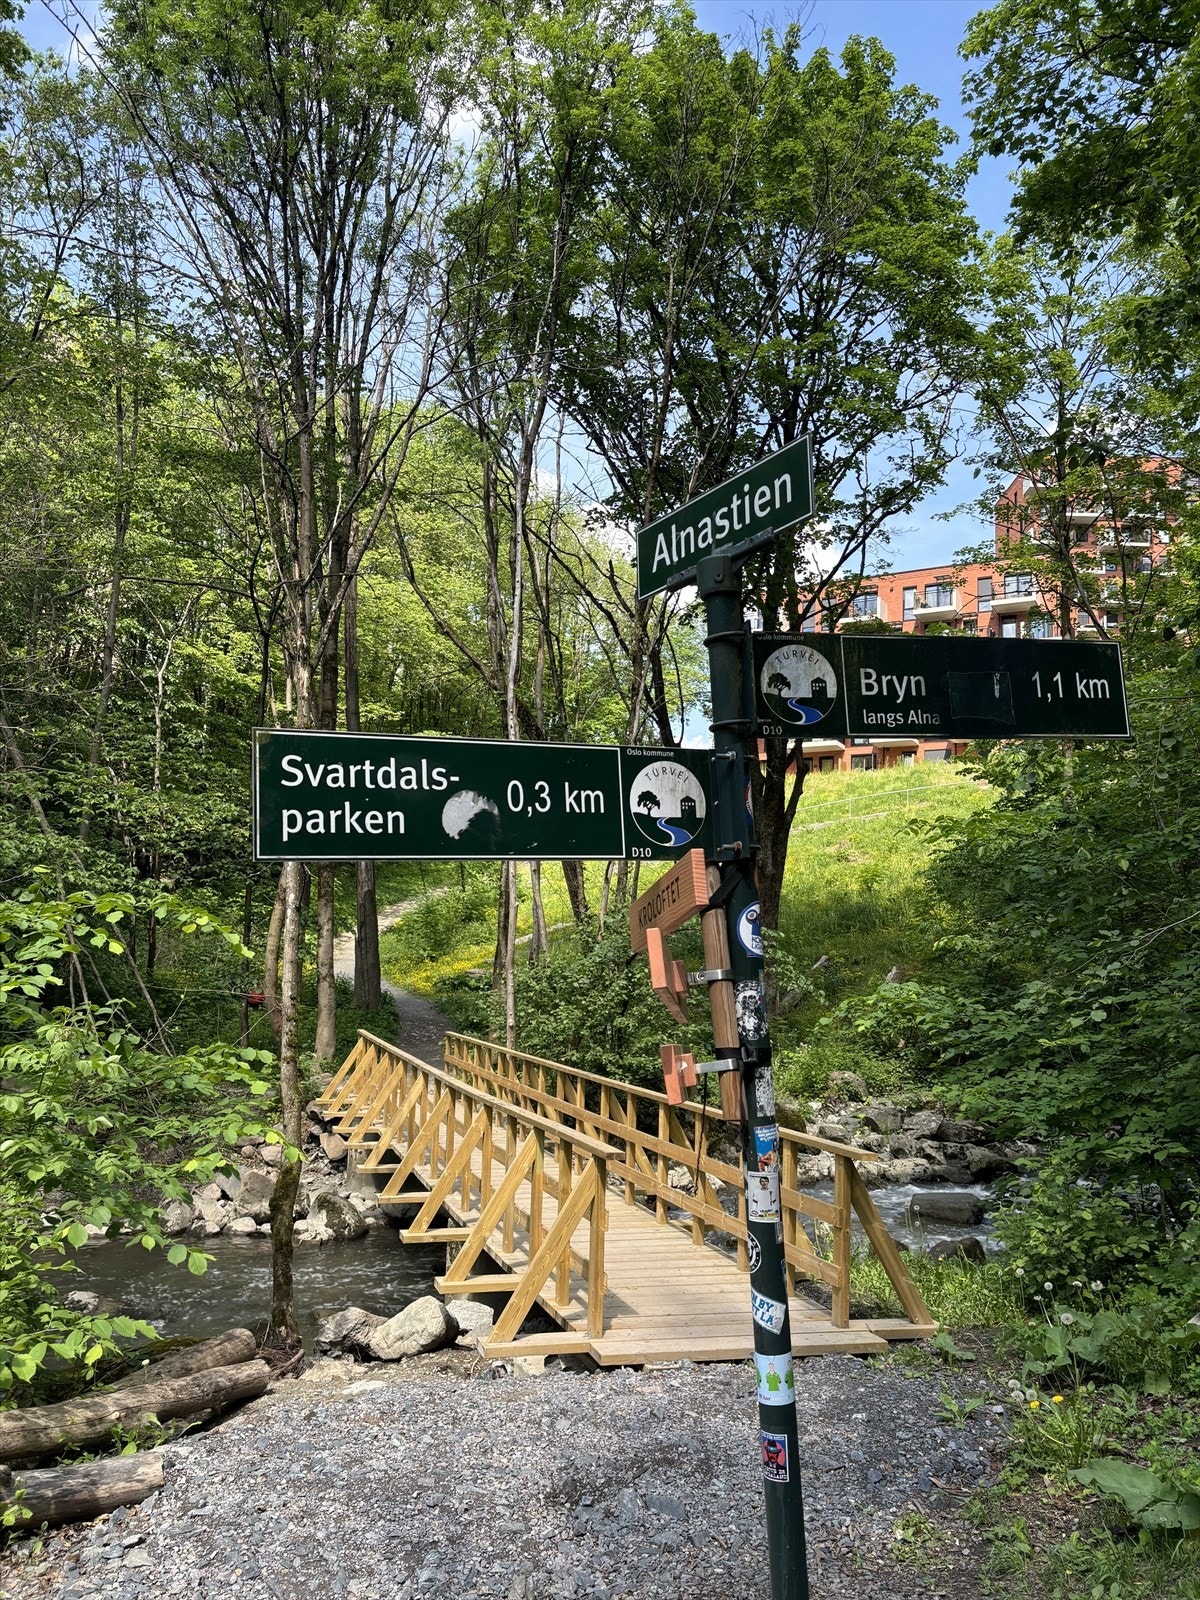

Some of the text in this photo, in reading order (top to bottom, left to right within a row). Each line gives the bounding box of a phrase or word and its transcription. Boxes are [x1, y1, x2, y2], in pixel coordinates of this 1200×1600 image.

[652, 473, 792, 573] Alnastien
[773, 633, 805, 641] kommune
[774, 650, 820, 665] TURVEI
[860, 668, 1110, 703] Bryn 1,1 km
[863, 708, 941, 727] langs Alna
[763, 725, 783, 735] D10
[627, 748, 675, 757] Oslo kommune
[644, 766, 690, 783] TURVEI
[281, 754, 605, 817] Svartdals- 0,3 km
[281, 801, 405, 842] parken
[632, 847, 652, 858] D10
[637, 876, 680, 930] KROLOFTET
